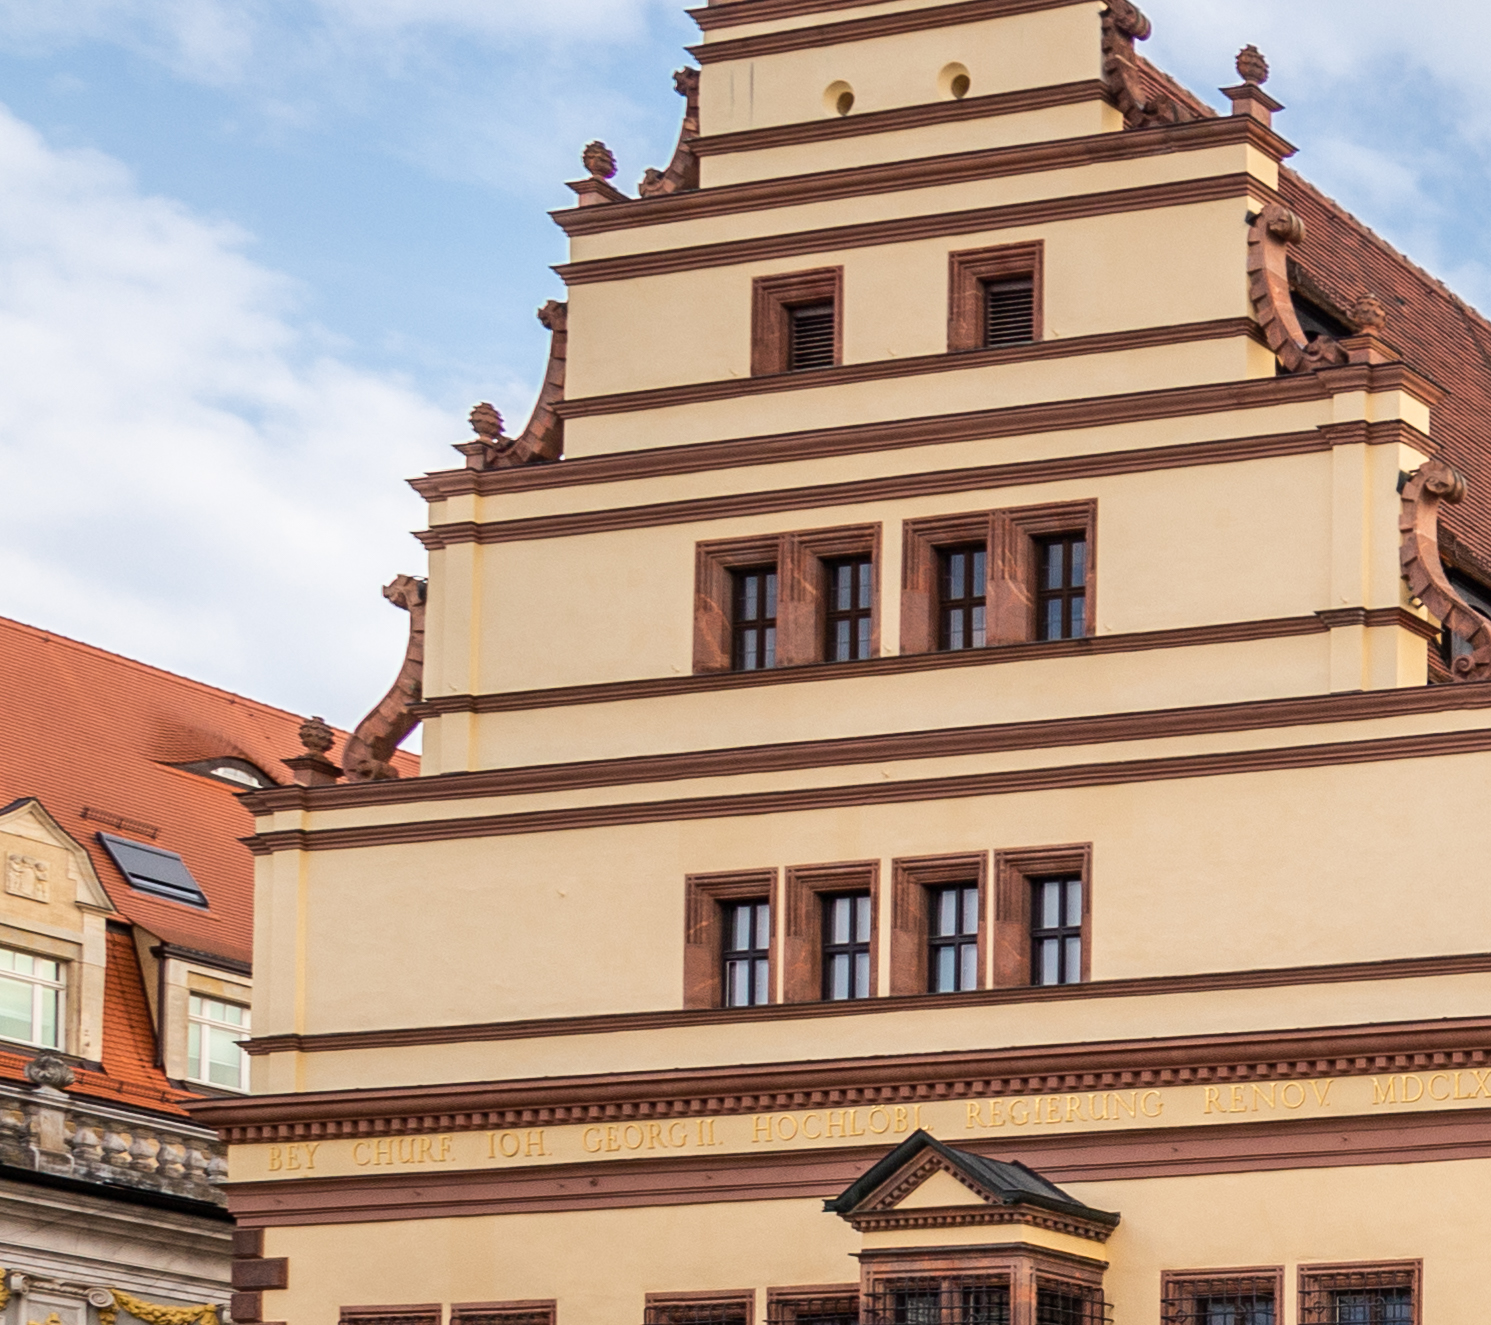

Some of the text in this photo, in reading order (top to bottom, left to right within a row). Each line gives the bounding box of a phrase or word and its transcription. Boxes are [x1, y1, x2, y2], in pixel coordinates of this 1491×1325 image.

[268, 1142, 320, 1172] BEY
[583, 1121, 687, 1154] GEORG
[964, 1088, 1164, 1130] REGIERUNG
